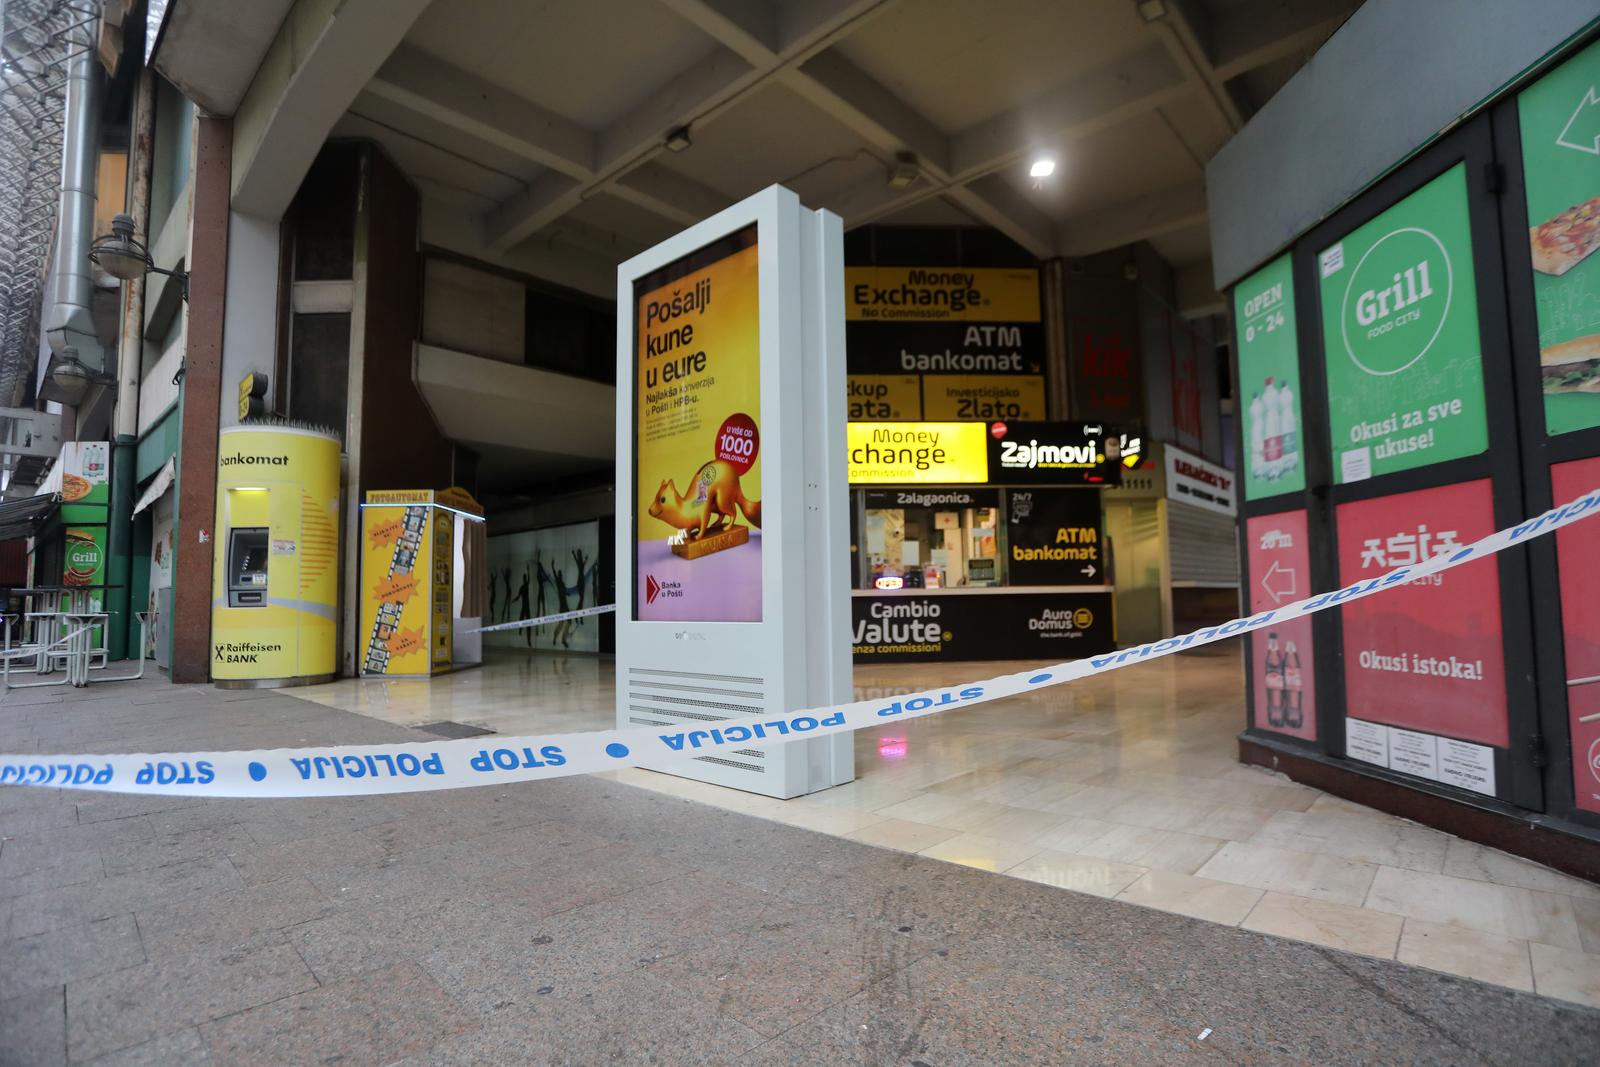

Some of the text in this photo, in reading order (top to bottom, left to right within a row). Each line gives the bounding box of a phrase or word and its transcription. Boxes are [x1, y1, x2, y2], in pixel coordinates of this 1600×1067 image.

[908, 270, 974, 288] Money
[647, 278, 711, 328] Pošalji
[1244, 283, 1283, 318] OPEN
[1355, 260, 1433, 326] Grill
[862, 308, 949, 318] No Commission
[1266, 311, 1284, 333] 24
[1368, 309, 1420, 340] FOOD CITY
[647, 324, 693, 359] kune
[963, 326, 1022, 347] ATM
[646, 351, 706, 388] u eure
[901, 349, 1023, 370] bankomat
[646, 386, 677, 404] Najlakša
[847, 381, 888, 399] kup
[651, 403, 669, 415] Pošti
[848, 399, 891, 418] ata
[1350, 398, 1462, 442] Okusi za sve
[720, 434, 753, 456] 1000
[873, 429, 939, 448] Money
[1374, 428, 1434, 459] ukuse!
[220, 452, 289, 466] bankomat
[848, 443, 945, 469] change
[848, 468, 914, 478] ommission
[1055, 528, 1096, 543] ATM
[72, 552, 97, 563] Grill
[1013, 546, 1097, 560] bankomat
[661, 581, 681, 589] Banka
[667, 589, 683, 598] Pošti
[1302, 569, 1410, 610] STOP
[871, 600, 941, 618] Cambio
[1042, 609, 1072, 620] Auro
[1029, 619, 1073, 630] Domus
[227, 642, 281, 652] Raiffeisen
[852, 643, 941, 653] enza commissioni
[1090, 612, 1277, 669] POLICIJA
[227, 655, 257, 663] BANK
[1359, 650, 1483, 680] Okusi istoka!
[877, 686, 985, 717] STOP
[658, 711, 846, 751] POLICIJA
[290, 751, 445, 780] POLICIJA
[470, 745, 567, 772] STOP
[1, 764, 113, 785] POLICIJ
[136, 760, 215, 785] STOP
